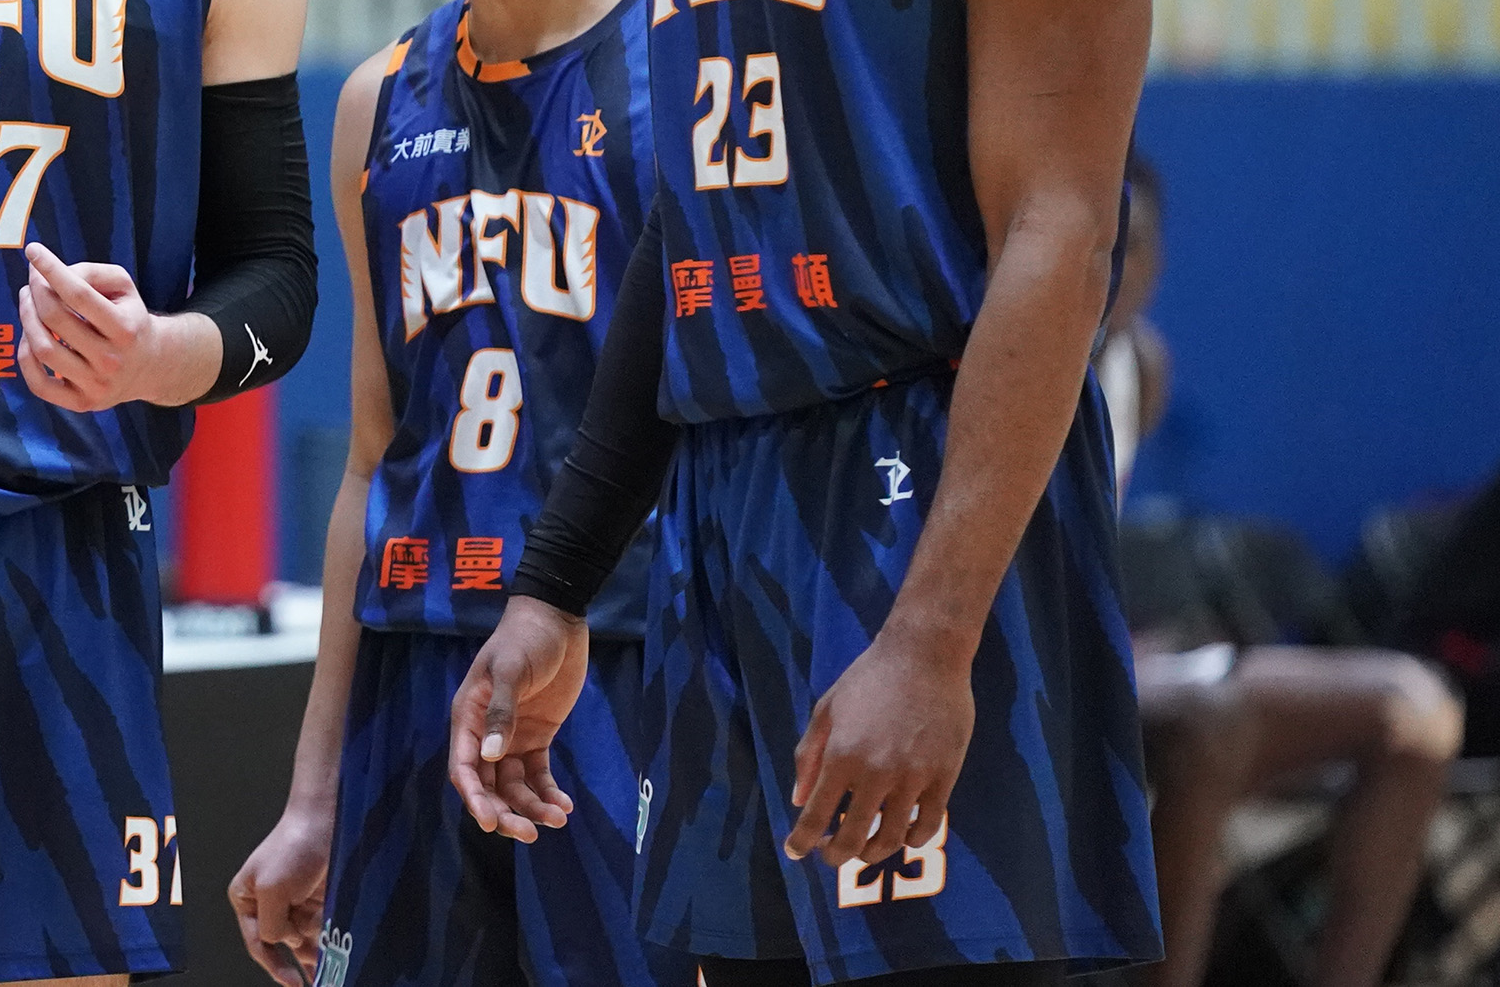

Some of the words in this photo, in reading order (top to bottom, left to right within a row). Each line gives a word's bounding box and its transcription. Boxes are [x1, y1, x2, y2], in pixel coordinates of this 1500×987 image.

[693, 51, 790, 191] 23
[399, 188, 601, 344] NFU
[671, 253, 838, 318] 摩曼頓
[448, 347, 524, 474] 8
